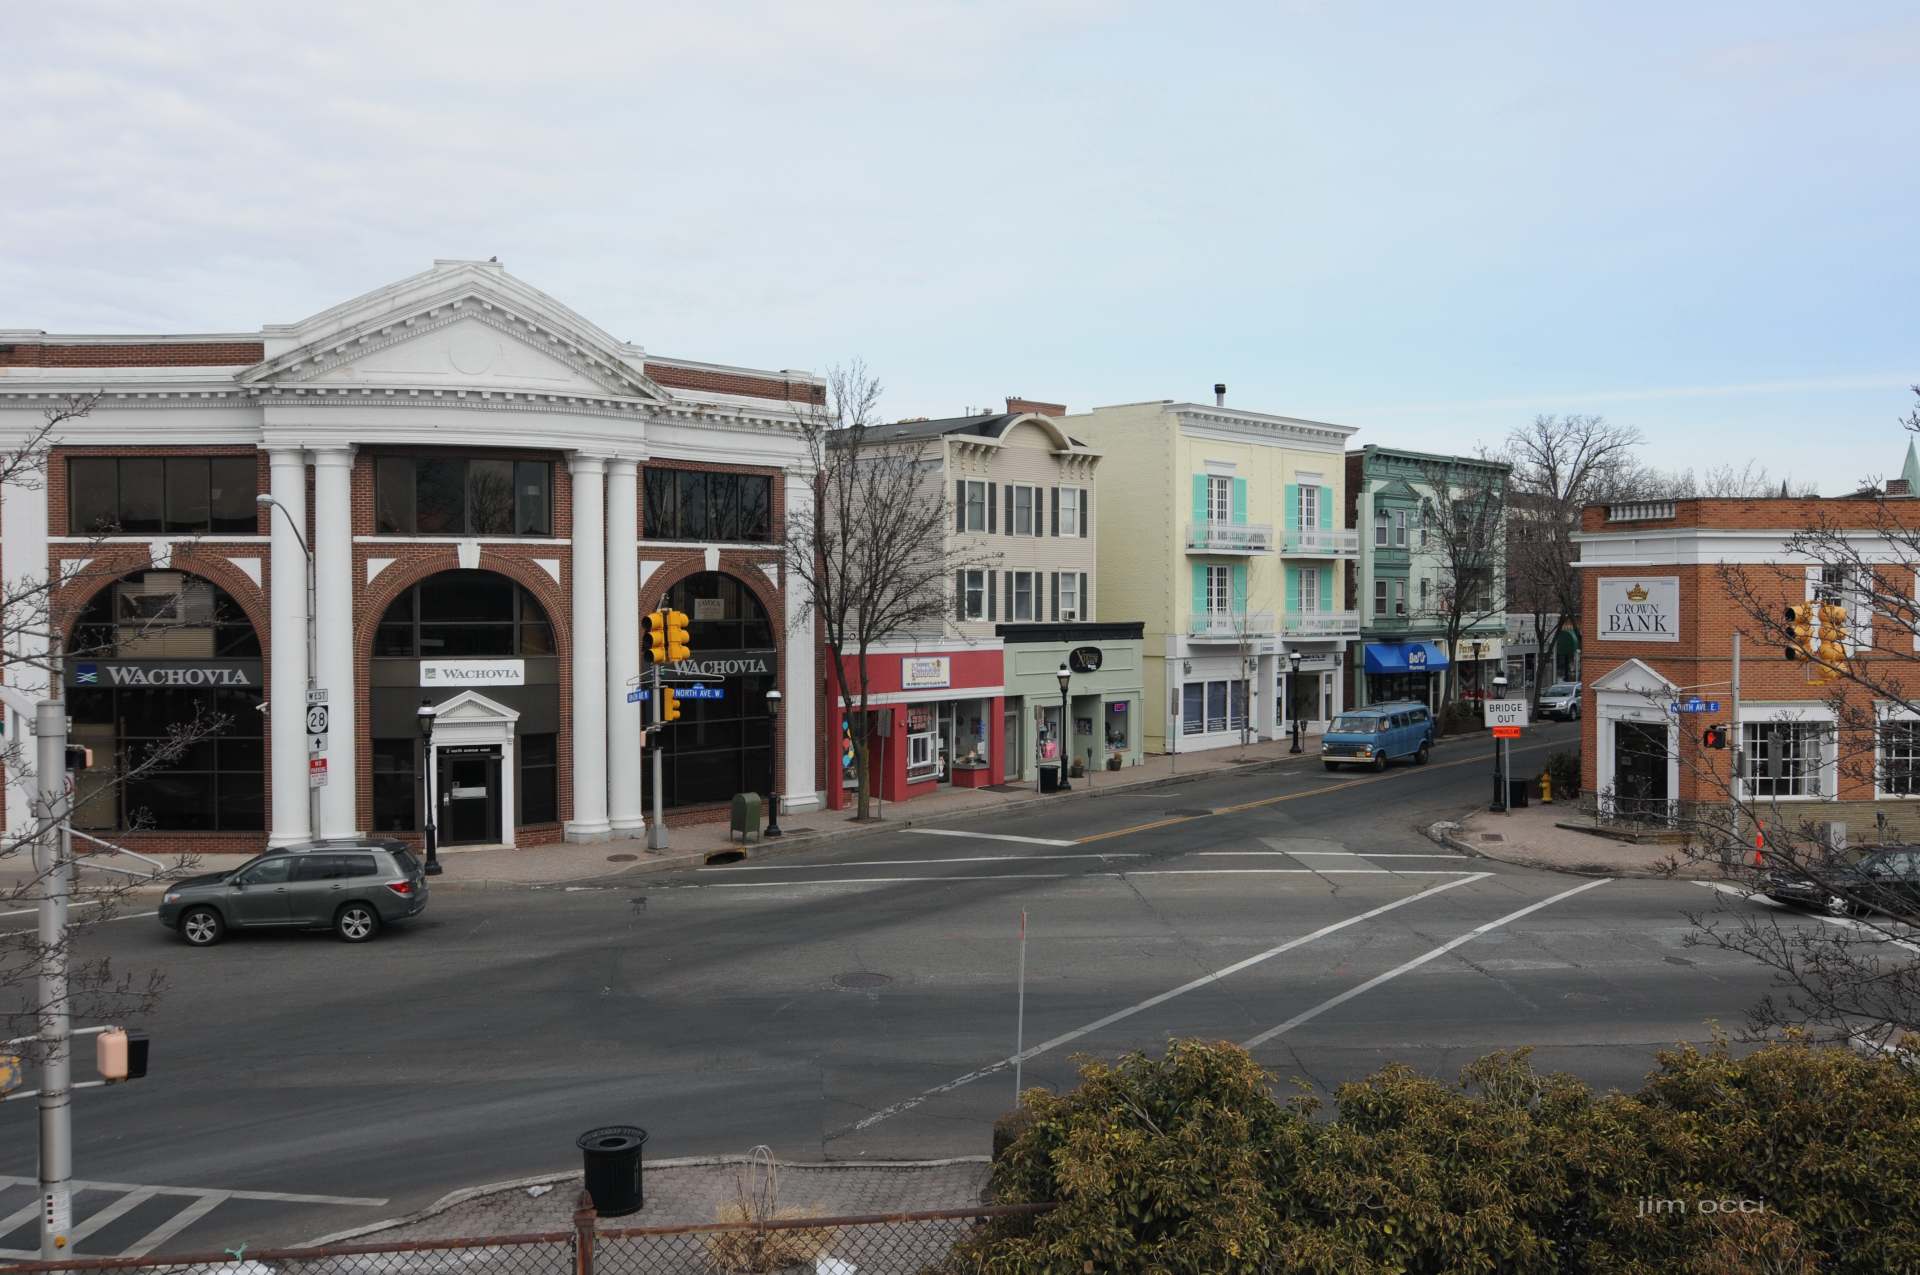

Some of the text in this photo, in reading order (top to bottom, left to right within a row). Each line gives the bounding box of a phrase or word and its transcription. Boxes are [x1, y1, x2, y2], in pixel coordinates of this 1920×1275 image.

[1615, 603, 1659, 614] CROWN
[1608, 614, 1667, 632] BANK
[673, 659, 768, 676] WACHOVIA
[105, 666, 251, 685] WACHOVIA
[442, 669, 520, 679] WACHOVIA
[308, 691, 326, 701] WEST
[675, 689, 697, 698] NORTH
[1489, 703, 1523, 712] BRIDGE
[310, 712, 325, 727] 28
[1497, 714, 1516, 723] OUT
